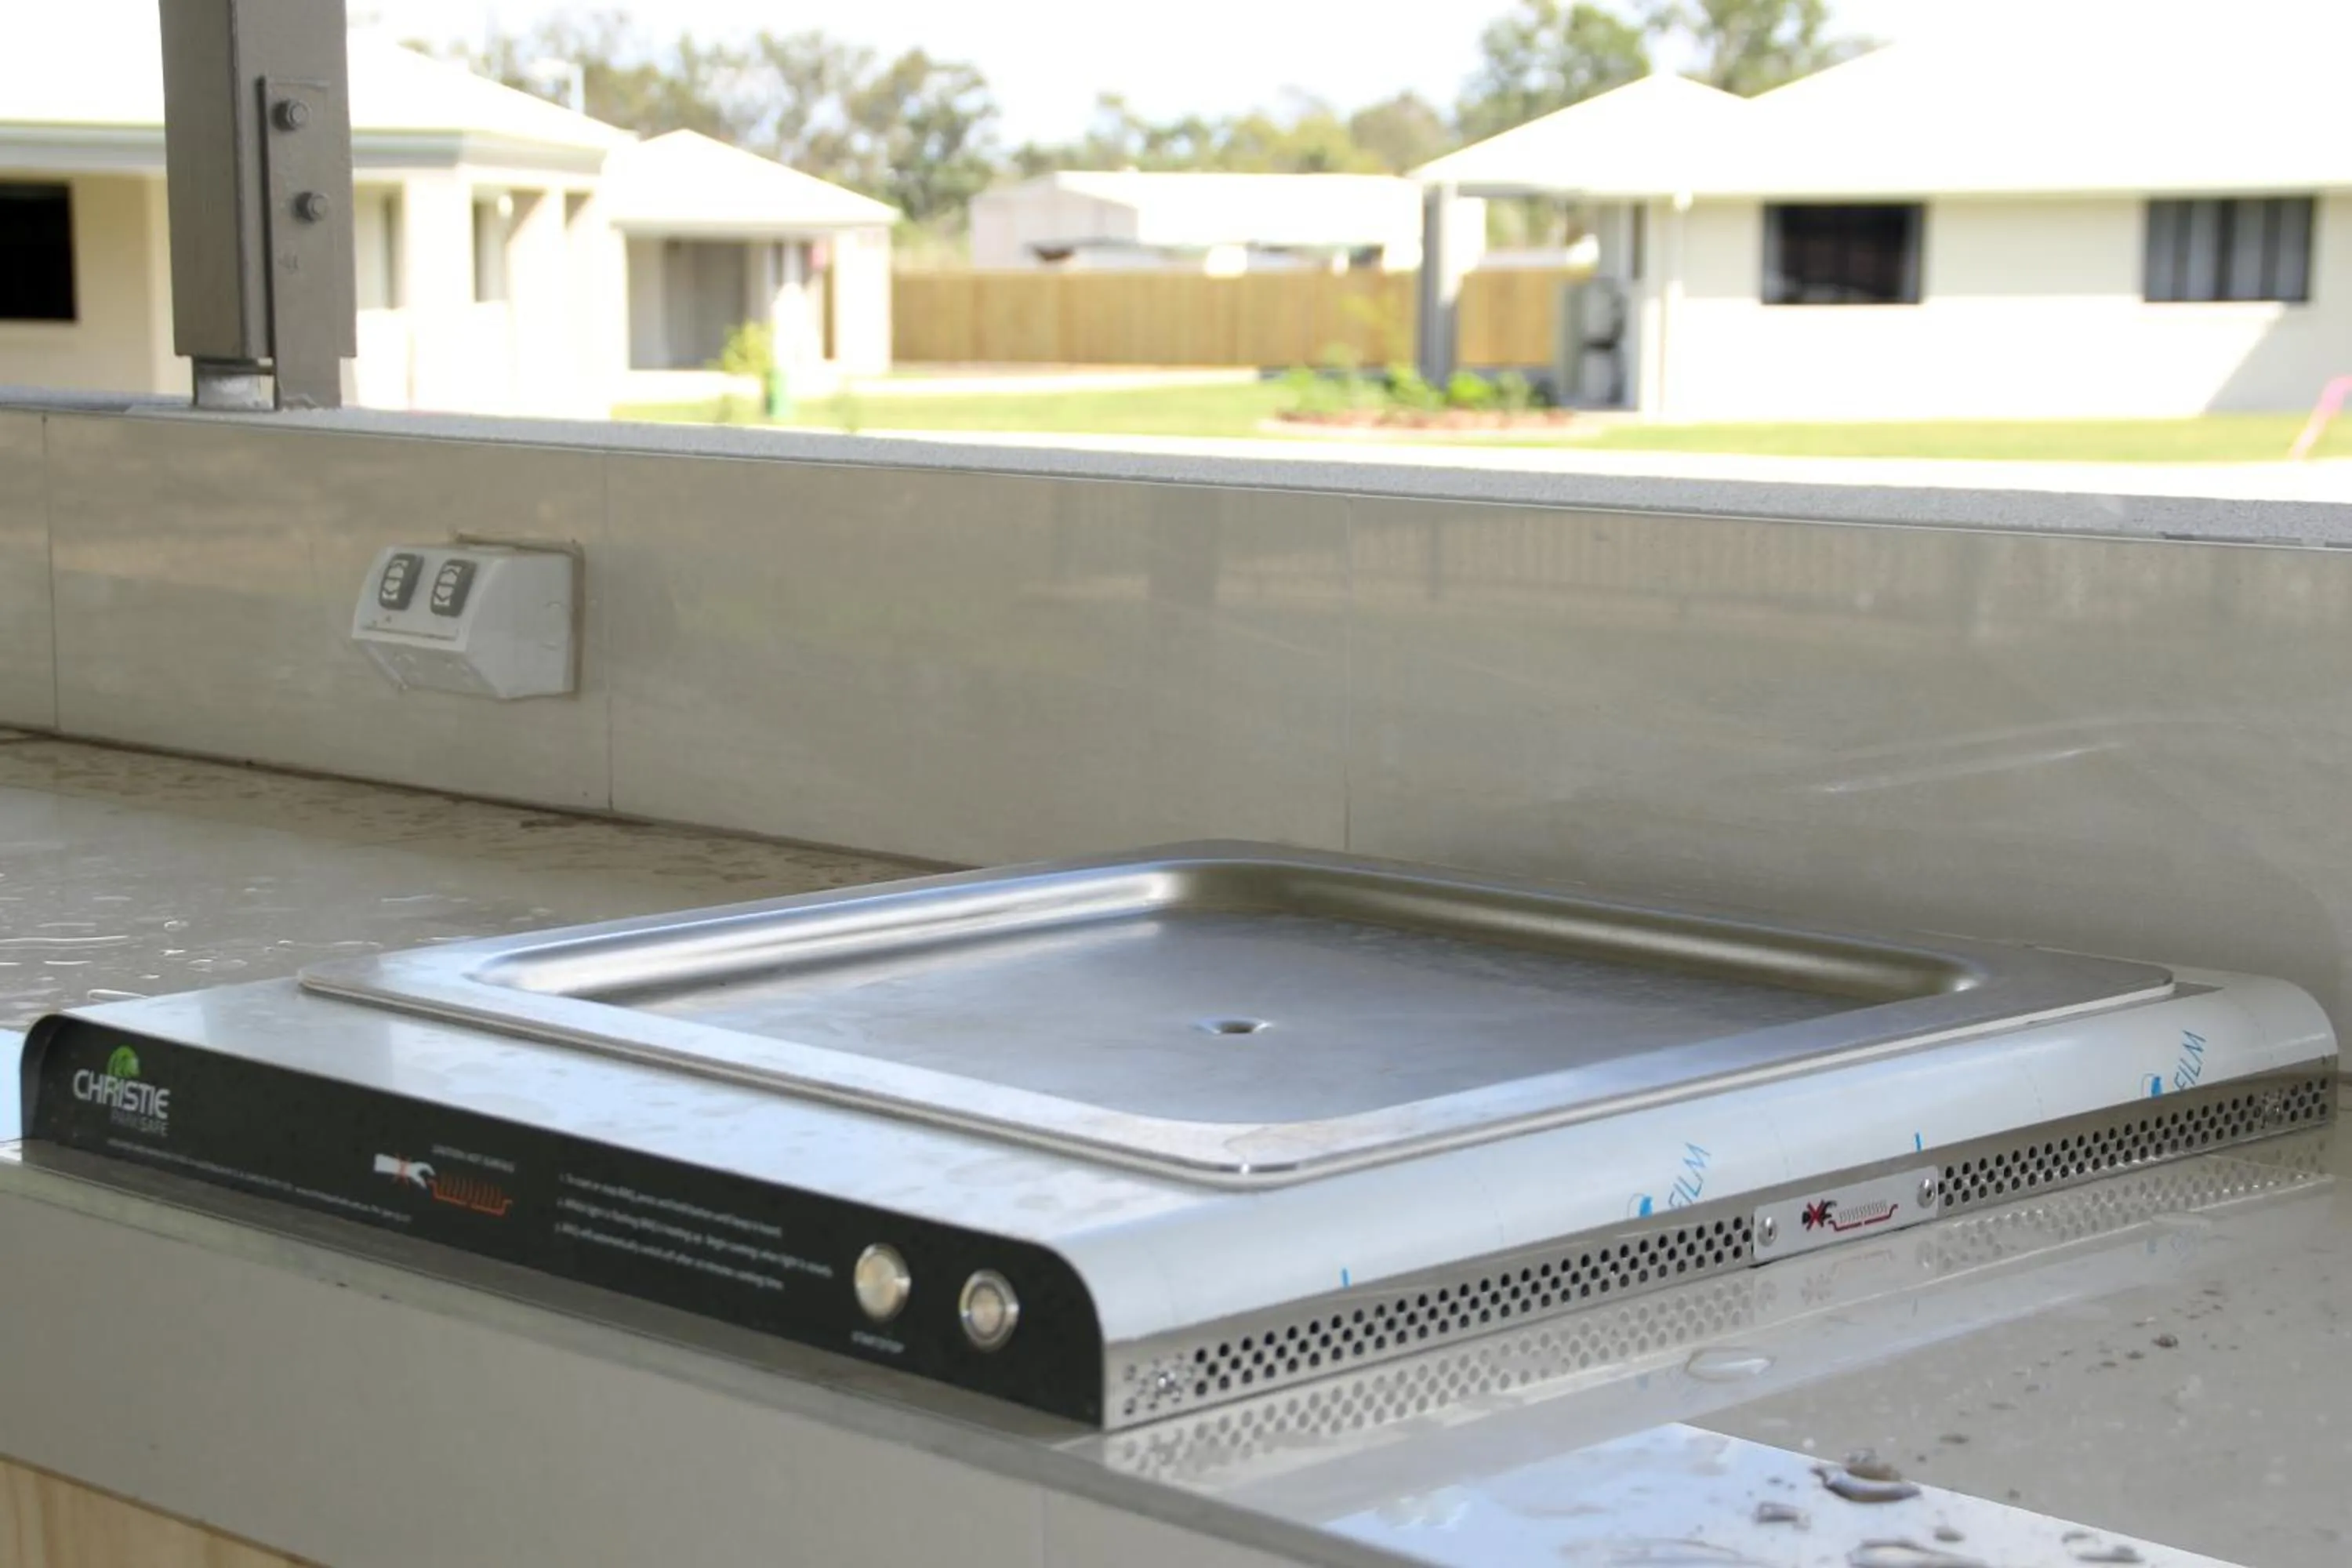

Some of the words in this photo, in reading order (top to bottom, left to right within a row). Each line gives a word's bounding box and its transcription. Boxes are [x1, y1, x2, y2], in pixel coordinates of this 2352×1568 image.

[2174, 1029, 2206, 1091] FILM
[73, 1069, 170, 1119] CHRISTIE
[1668, 1142, 1711, 1209] FILM
